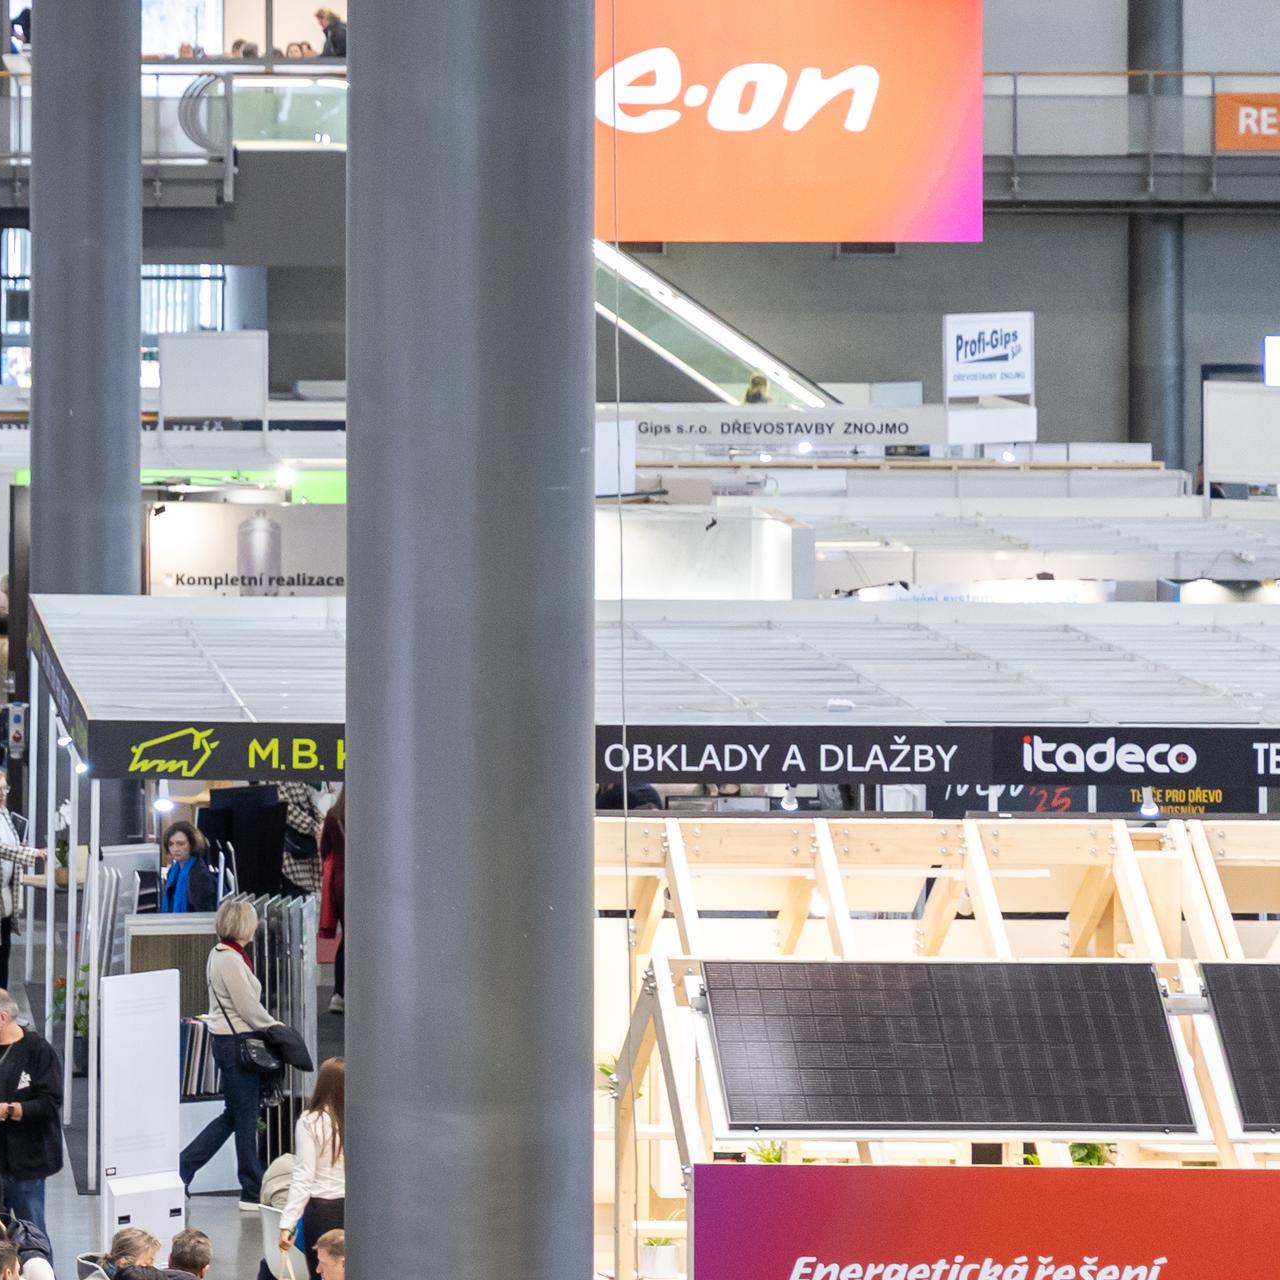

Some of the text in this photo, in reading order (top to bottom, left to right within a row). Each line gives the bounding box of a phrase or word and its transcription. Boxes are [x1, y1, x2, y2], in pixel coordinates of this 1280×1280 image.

[955, 327, 1019, 362] Profi-Gips
[638, 419, 910, 436] Gips s.r.o. DŘEVOSTAVBY ZNOJMO
[175, 572, 345, 589] Kompletní realizace
[247, 737, 326, 771] M.B.
[604, 735, 958, 773] OBKLADY A DLAŽBY
[1022, 735, 1198, 774] itadeco
[1165, 788, 1187, 803] PRO
[1188, 786, 1223, 803] DŘEVO
